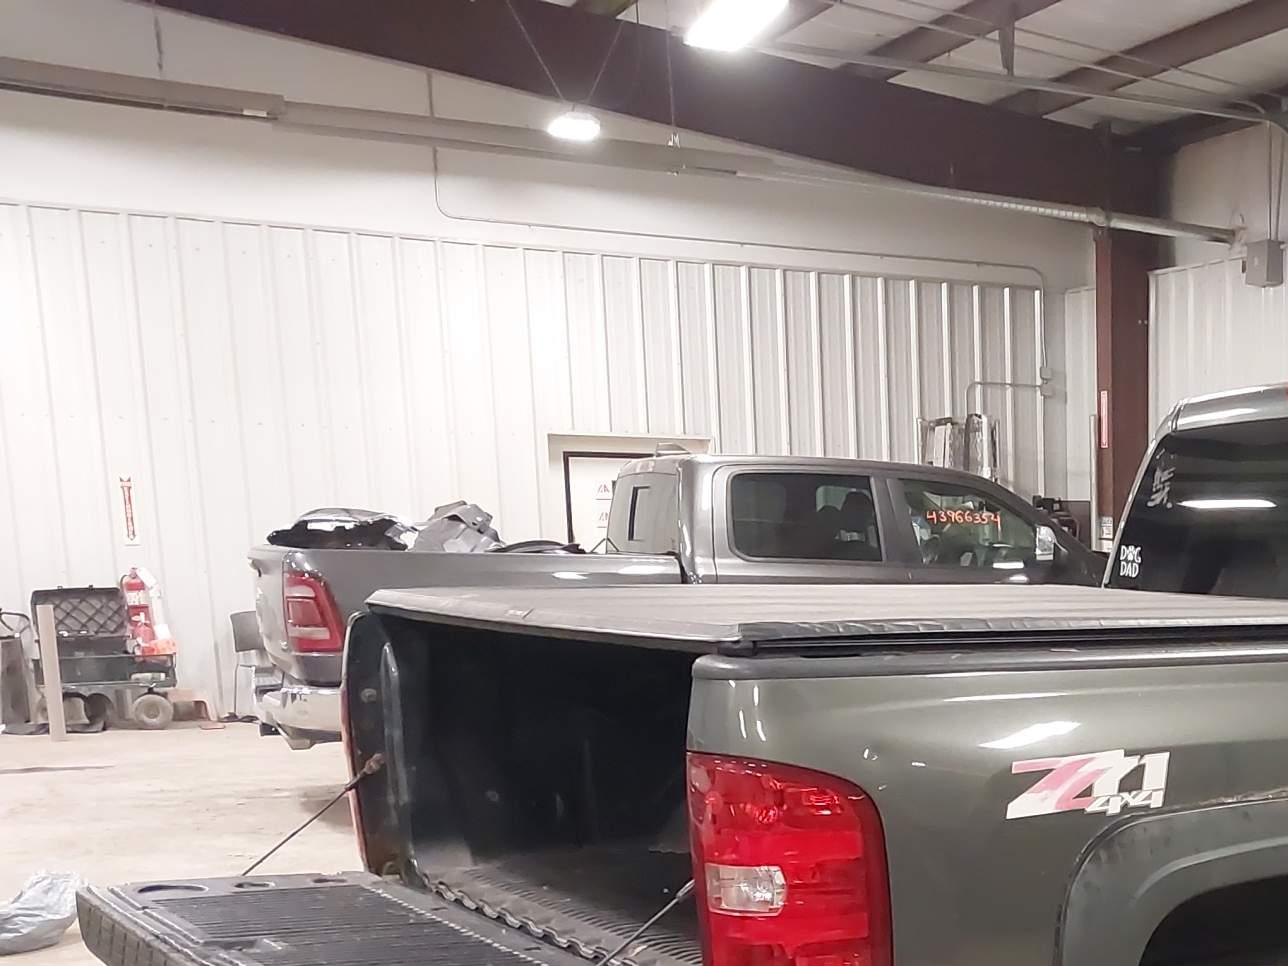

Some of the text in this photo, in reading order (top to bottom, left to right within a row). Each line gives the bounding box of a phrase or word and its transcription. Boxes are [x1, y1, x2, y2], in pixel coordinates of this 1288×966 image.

[926, 510, 1002, 526] 43966354
[1120, 561, 1139, 578] DAD
[1006, 749, 1170, 820] Z71
